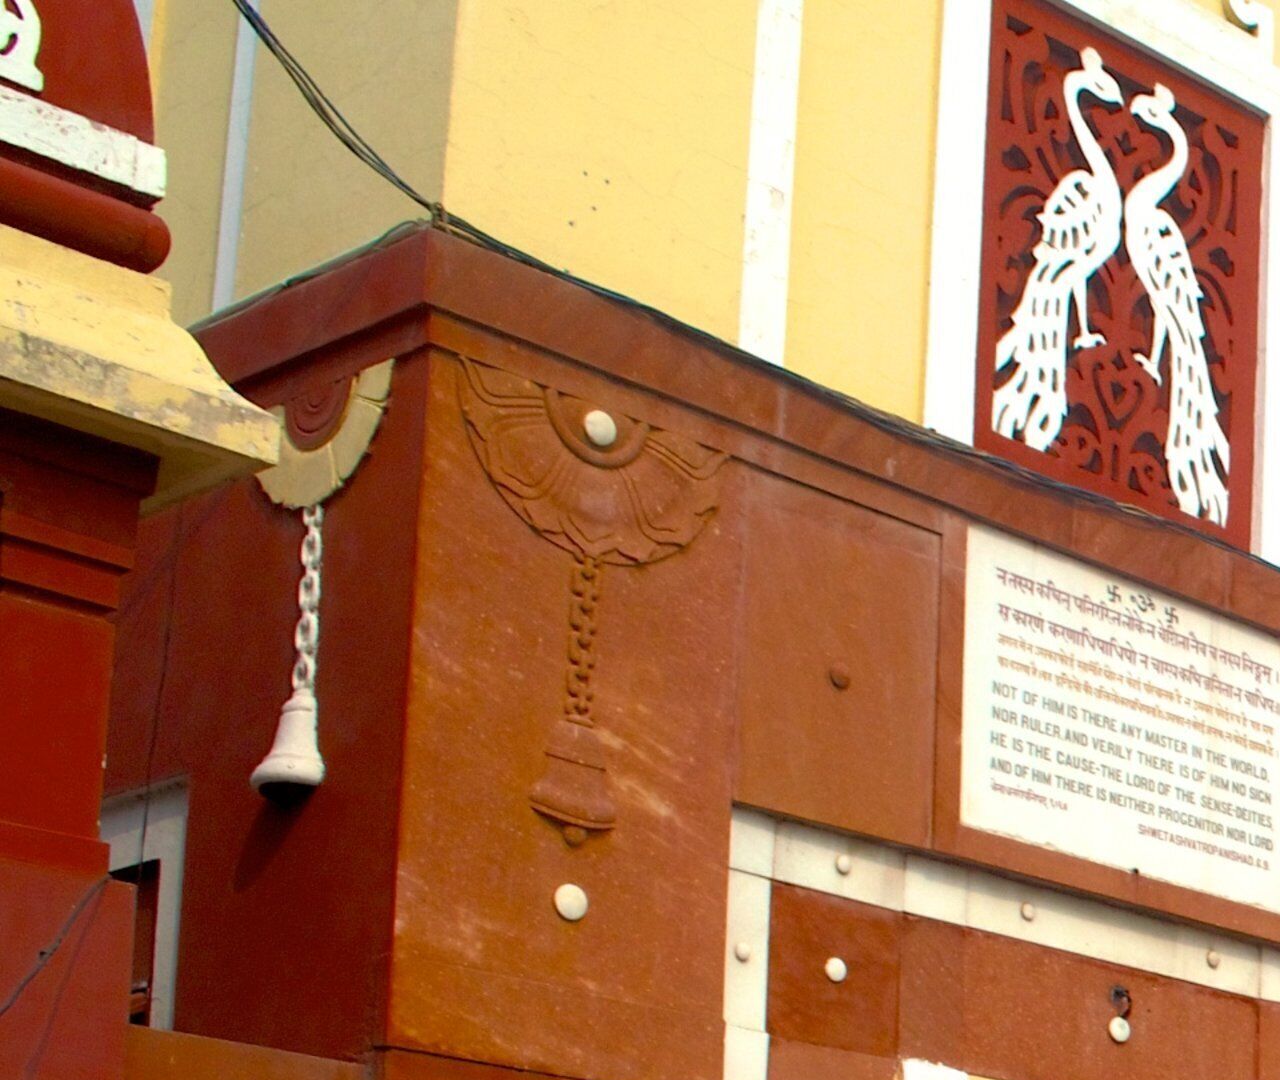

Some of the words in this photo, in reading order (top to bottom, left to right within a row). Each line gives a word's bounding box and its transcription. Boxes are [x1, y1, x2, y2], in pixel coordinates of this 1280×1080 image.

[989, 730, 1007, 748] HE
[1011, 737, 1023, 753] IS
[1027, 741, 1051, 761] THE
[1125, 772, 1155, 792] LORD
[1156, 781, 1171, 796] OF
[1174, 786, 1195, 805] THE
[991, 680, 1017, 699] NOT
[1021, 690, 1038, 706] OF
[1041, 696, 1064, 715] HIM
[1066, 704, 1078, 720] IS
[1081, 708, 1116, 732] THERE
[1120, 722, 1141, 739] ANY
[1144, 730, 1187, 754] MASTER
[1191, 744, 1202, 759] IN
[1205, 748, 1226, 768] THE
[991, 705, 1017, 725] NOR
[1064, 728, 1088, 747] AND
[1091, 737, 1132, 760] VERILY
[1136, 750, 1174, 774] THERE
[1179, 764, 1189, 779] IS
[1191, 767, 1206, 783] OF
[1209, 774, 1229, 791] HIM
[1231, 781, 1246, 797] NO
[989, 757, 1012, 774] AND
[1013, 763, 1029, 779] OF
[1031, 768, 1051, 785] HIM
[1055, 774, 1093, 798] THERE
[1095, 786, 1107, 802] IS
[1108, 791, 1155, 815] NEITHER
[1158, 806, 1224, 835] PROGENITOR
[1225, 826, 1246, 843] NOR
[1248, 833, 1273, 852] LORD
